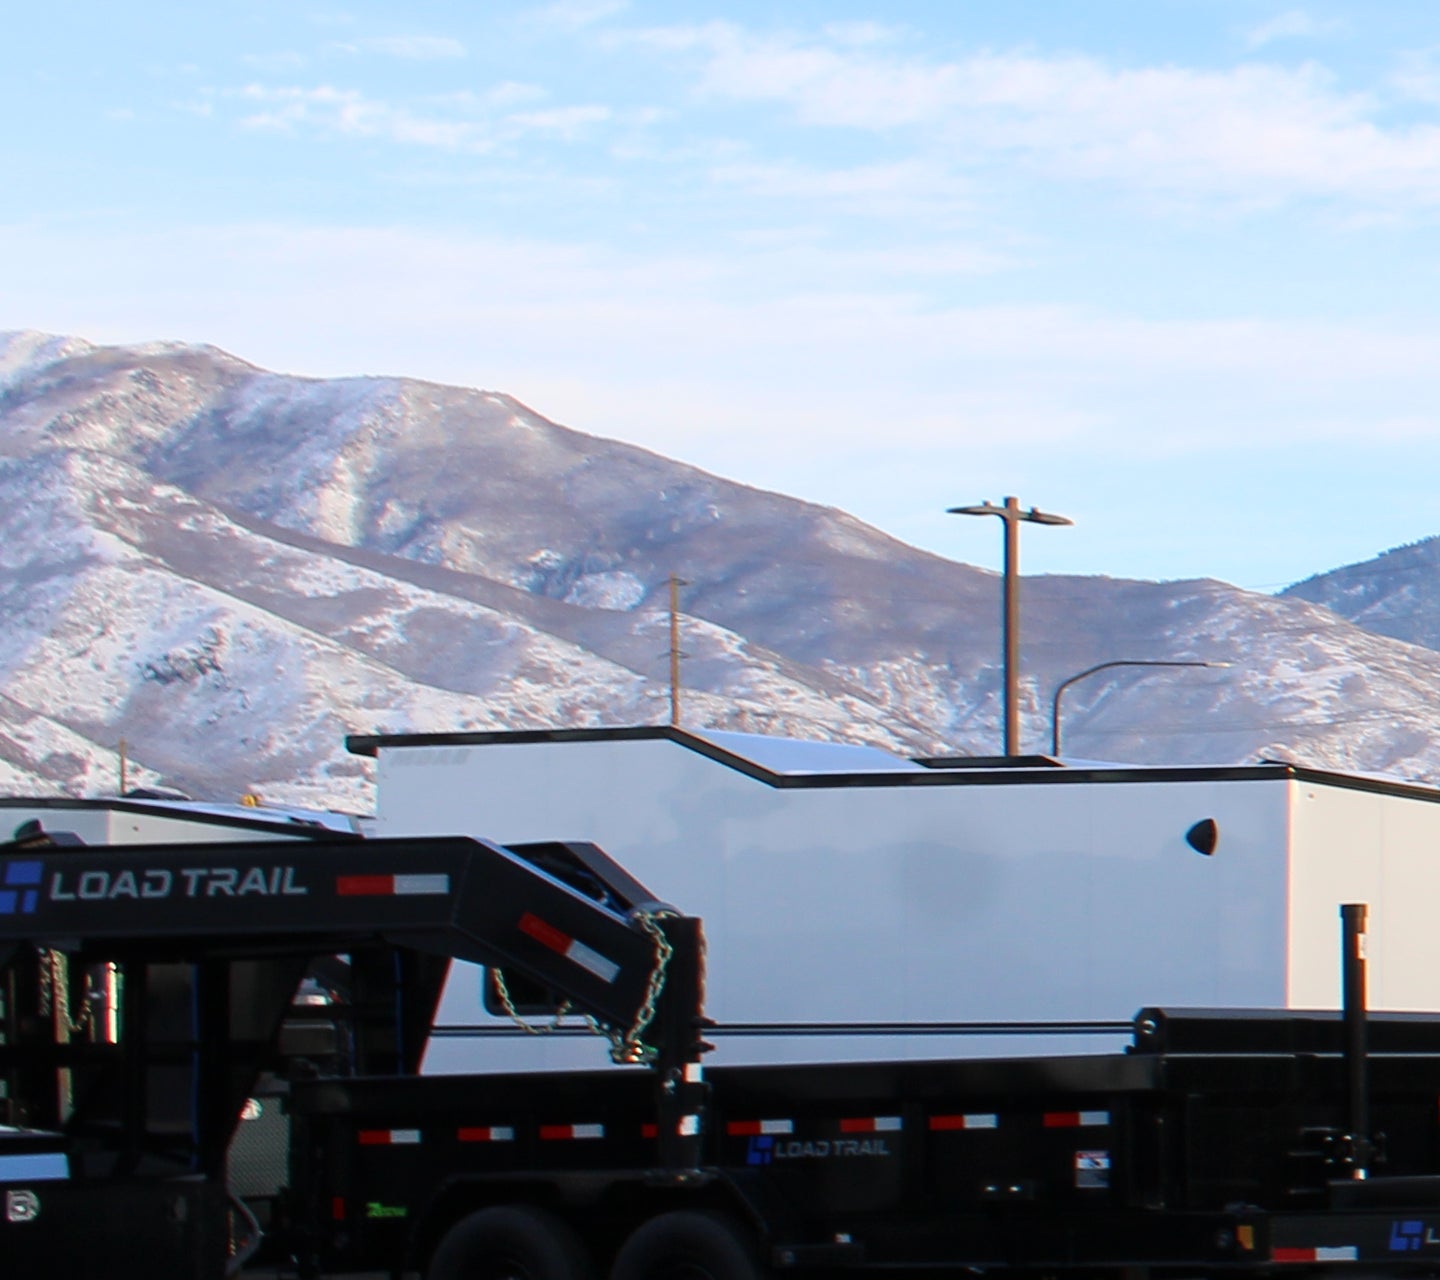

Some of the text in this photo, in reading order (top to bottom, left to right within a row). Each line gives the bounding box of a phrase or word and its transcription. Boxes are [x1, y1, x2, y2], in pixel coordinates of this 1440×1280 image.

[50, 866, 309, 900] LOAD TRAIL
[775, 1138, 891, 1158] LOAD TRAIL
